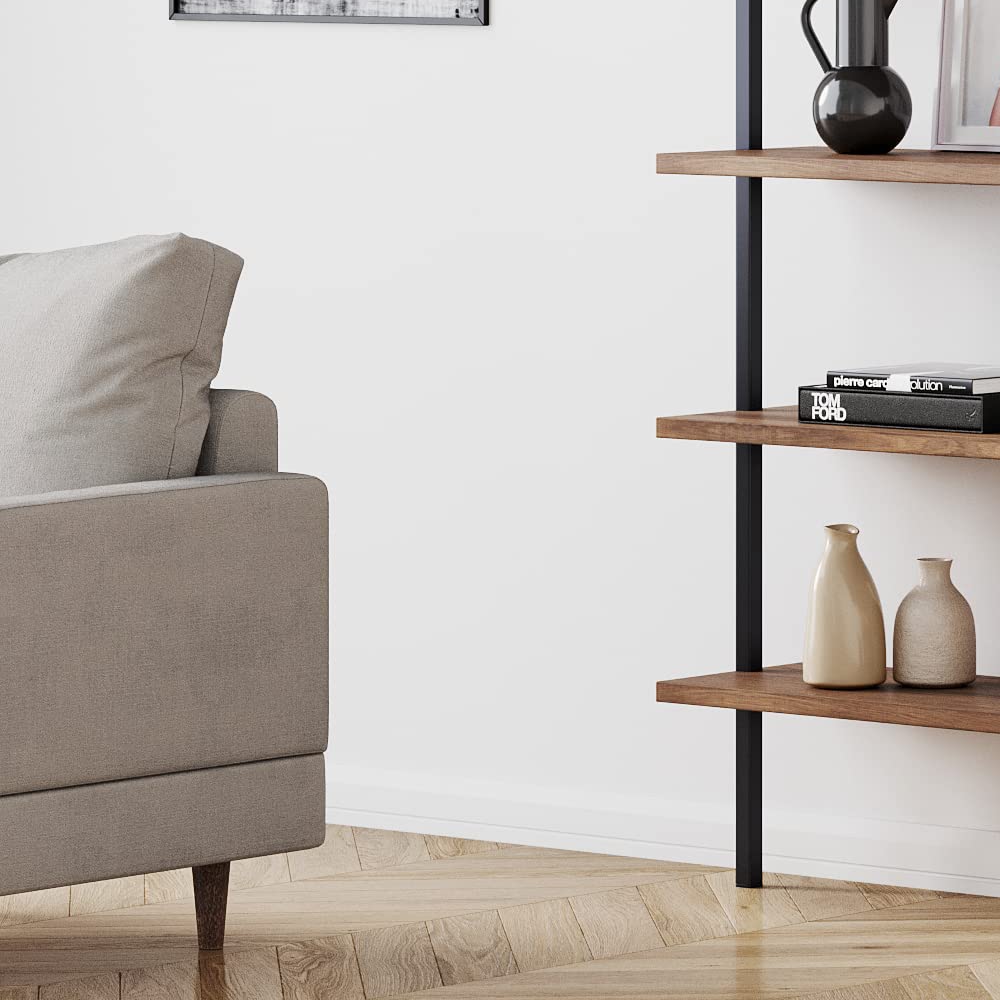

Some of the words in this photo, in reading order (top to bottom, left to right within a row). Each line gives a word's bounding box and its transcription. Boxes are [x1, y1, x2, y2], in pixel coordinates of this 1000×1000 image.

[833, 375, 865, 388] pierre
[865, 377, 888, 388] card
[910, 378, 943, 391] olution
[811, 392, 841, 408] TOM
[811, 405, 847, 421] FORD
